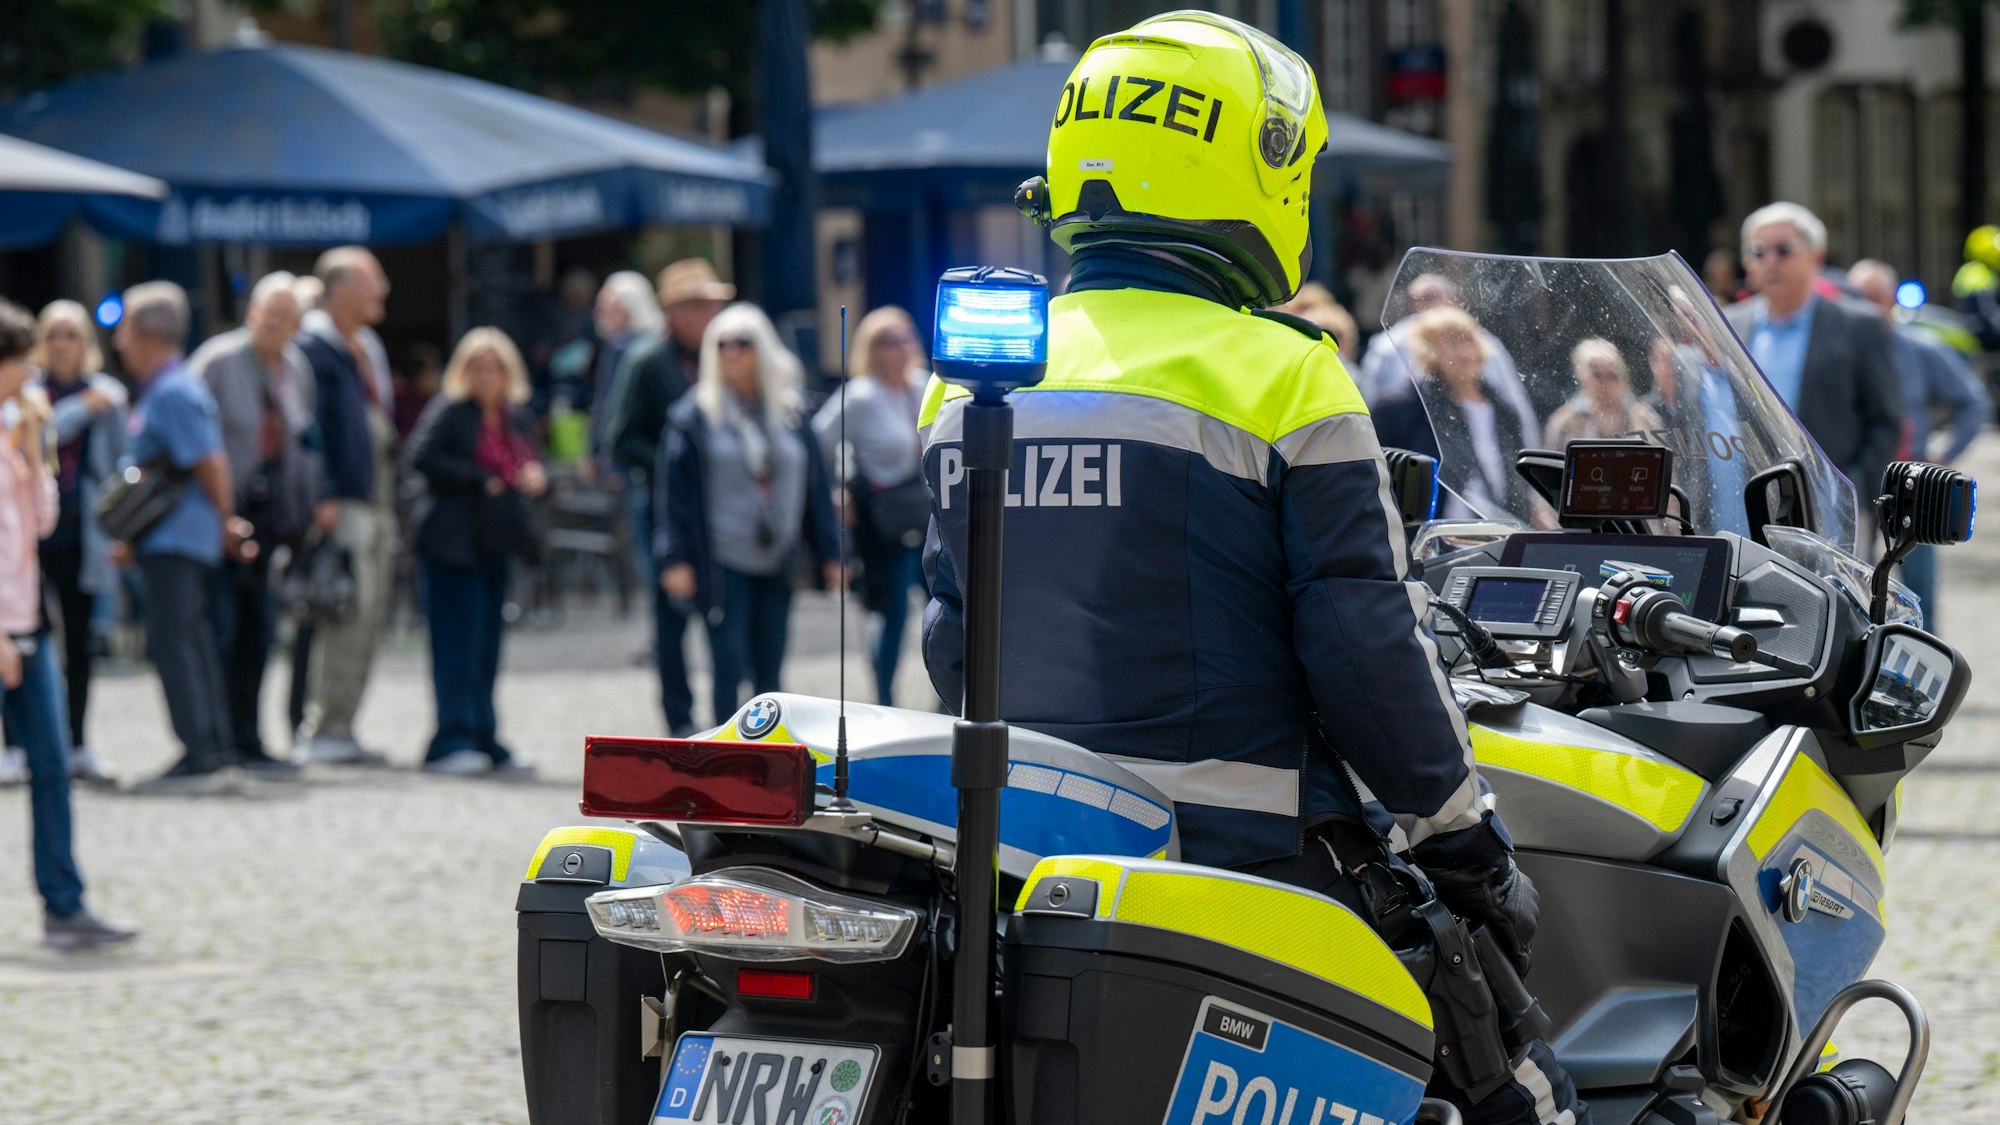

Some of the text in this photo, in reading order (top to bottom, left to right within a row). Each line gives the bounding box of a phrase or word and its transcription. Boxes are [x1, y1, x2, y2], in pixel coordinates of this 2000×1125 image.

[1054, 75, 1223, 143] OLIZEI
[939, 444, 1122, 510] PLIZEI
[1219, 1016, 1255, 1040] BMW
[670, 1087, 688, 1107] D
[693, 1050, 827, 1125] NRW
